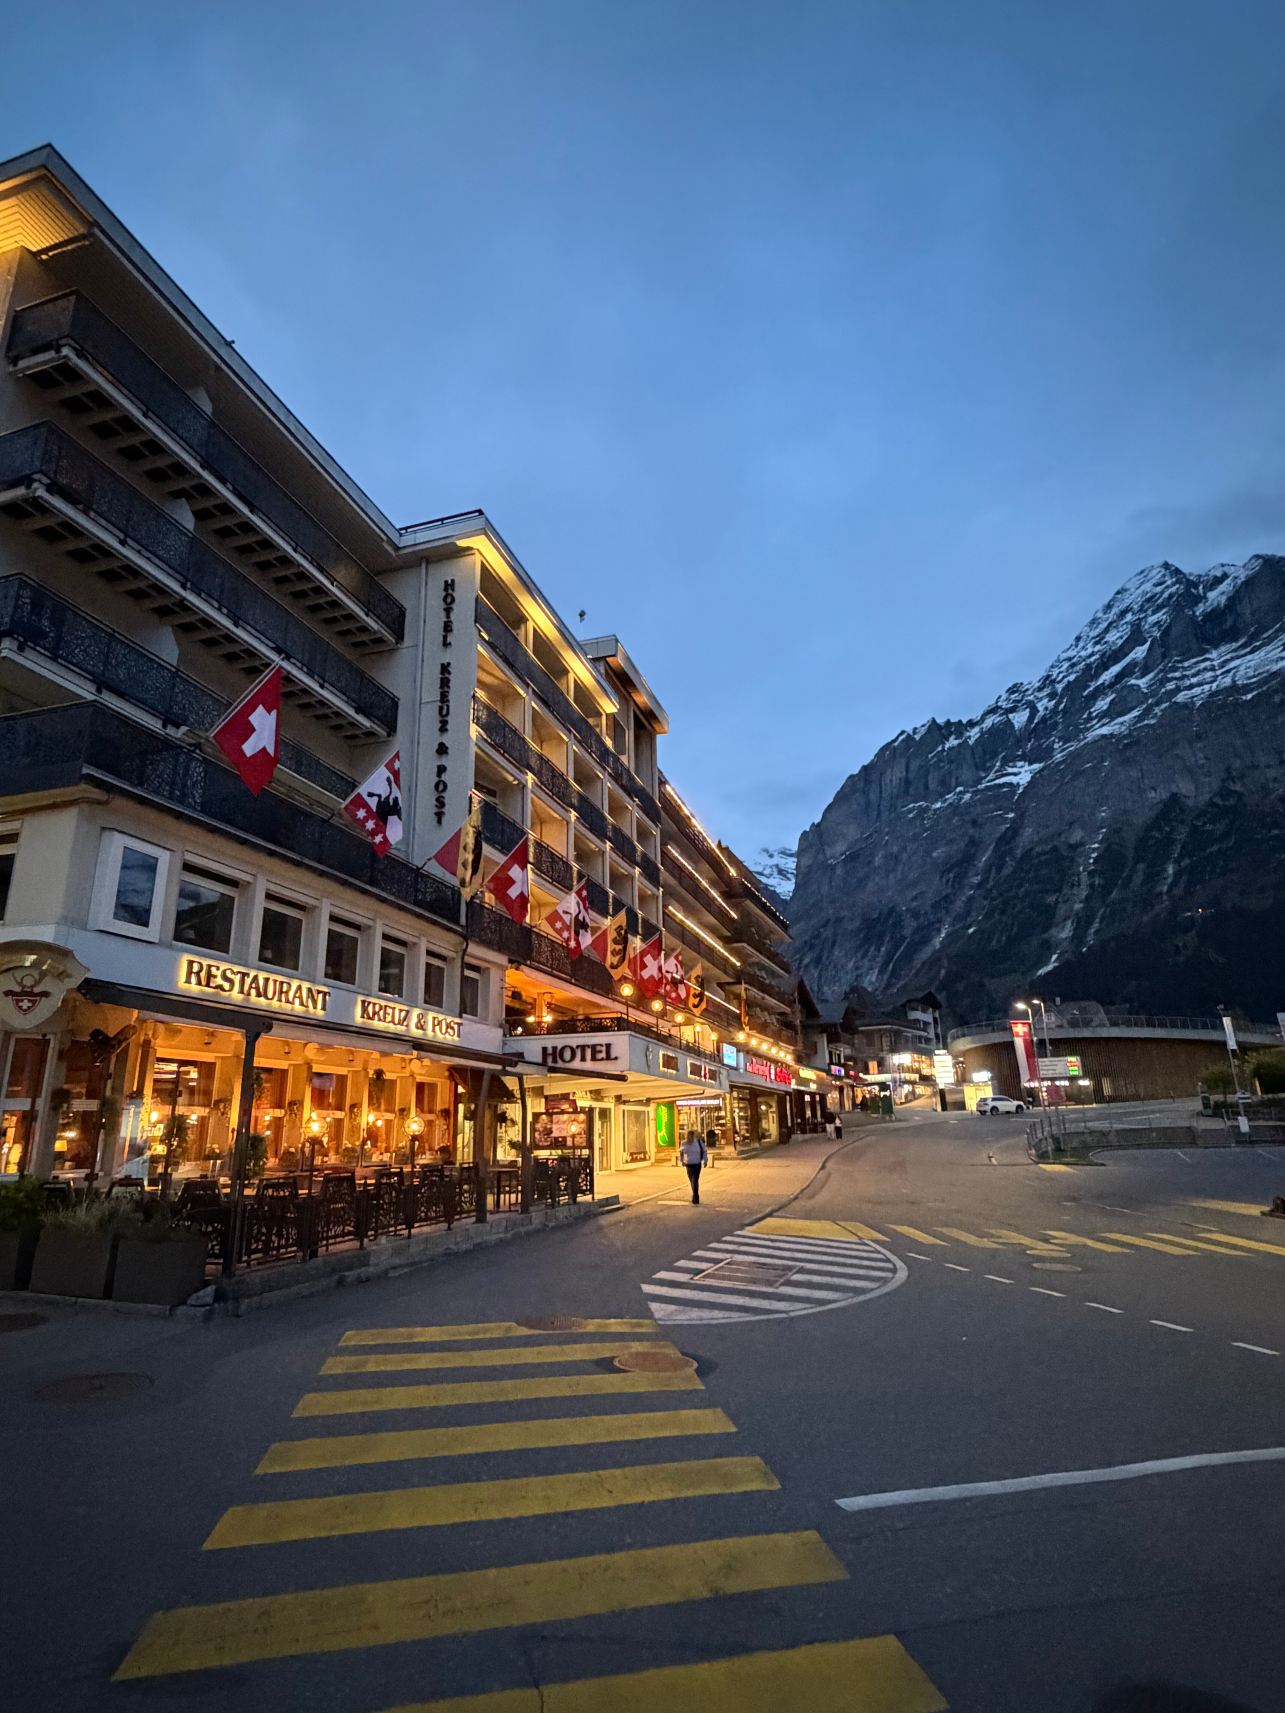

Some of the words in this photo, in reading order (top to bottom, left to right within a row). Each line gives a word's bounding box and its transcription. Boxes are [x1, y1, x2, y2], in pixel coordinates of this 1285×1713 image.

[442, 578, 455, 649] HOTEL
[439, 661, 452, 734] KREUZ
[435, 741, 449, 755] &
[434, 764, 448, 825] POST
[184, 958, 331, 1012] RESTAURANT
[359, 999, 410, 1028] KREUZ
[415, 1012, 426, 1032] &
[431, 1016, 464, 1040] POST
[541, 1042, 619, 1065] HOTEL
